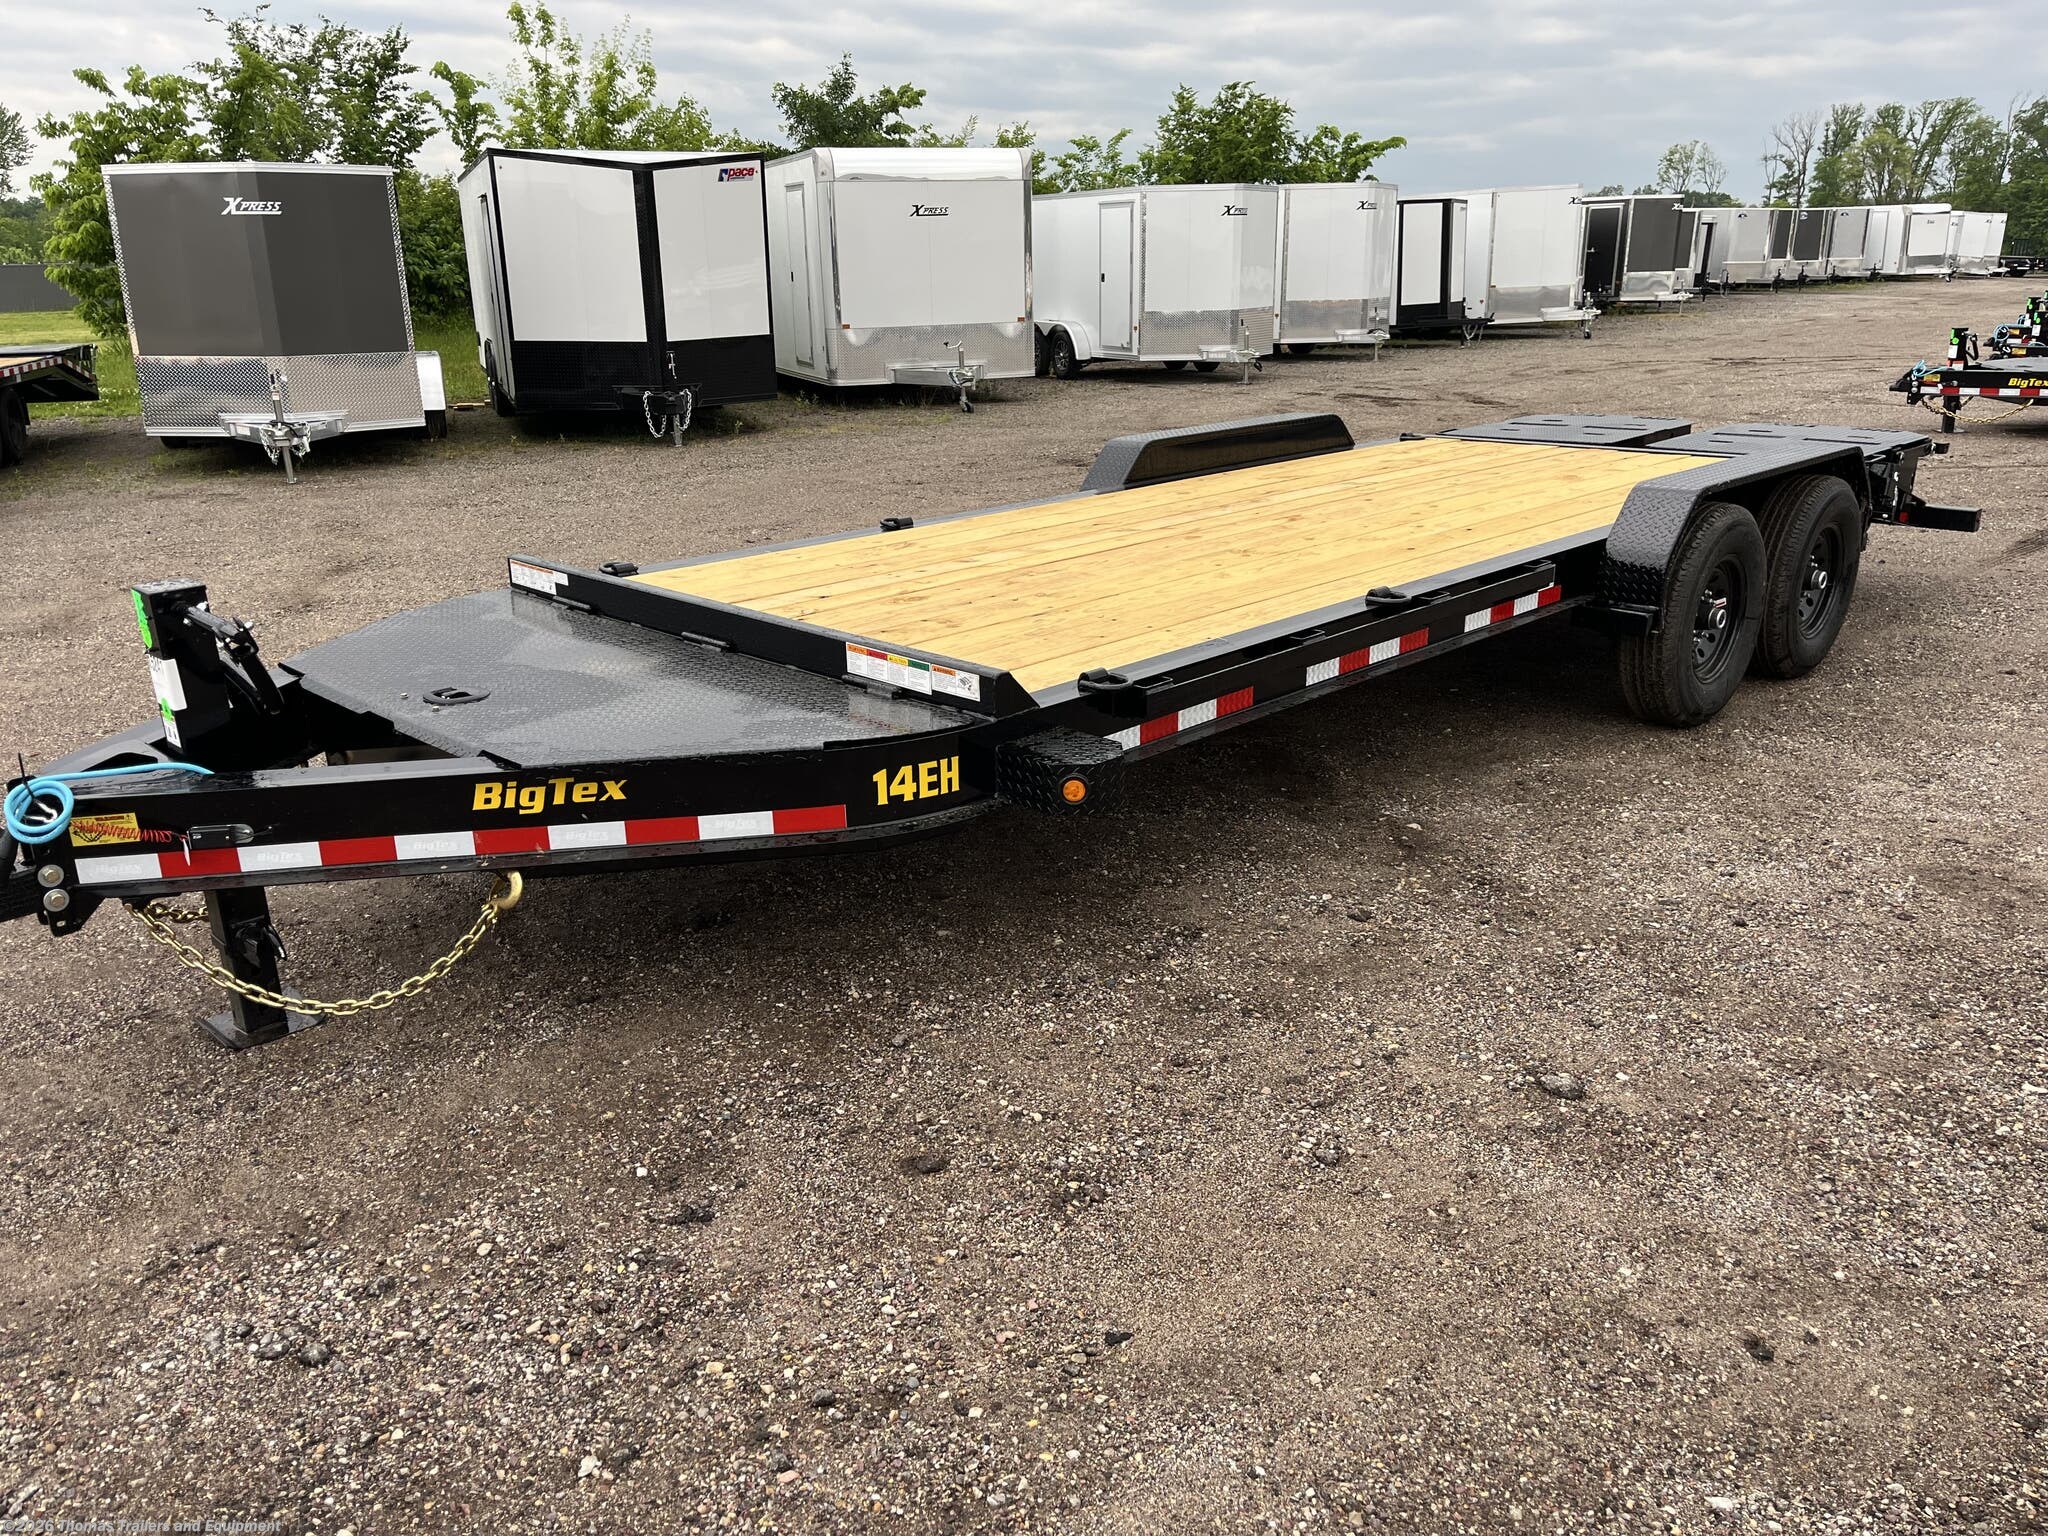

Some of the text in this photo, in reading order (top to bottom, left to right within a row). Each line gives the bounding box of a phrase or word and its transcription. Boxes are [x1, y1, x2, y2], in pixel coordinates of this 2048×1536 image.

[221, 197, 282, 215] XPRESS
[910, 204, 949, 217] XPRESS
[872, 755, 960, 806] 14EH
[472, 778, 628, 815] BigTex
